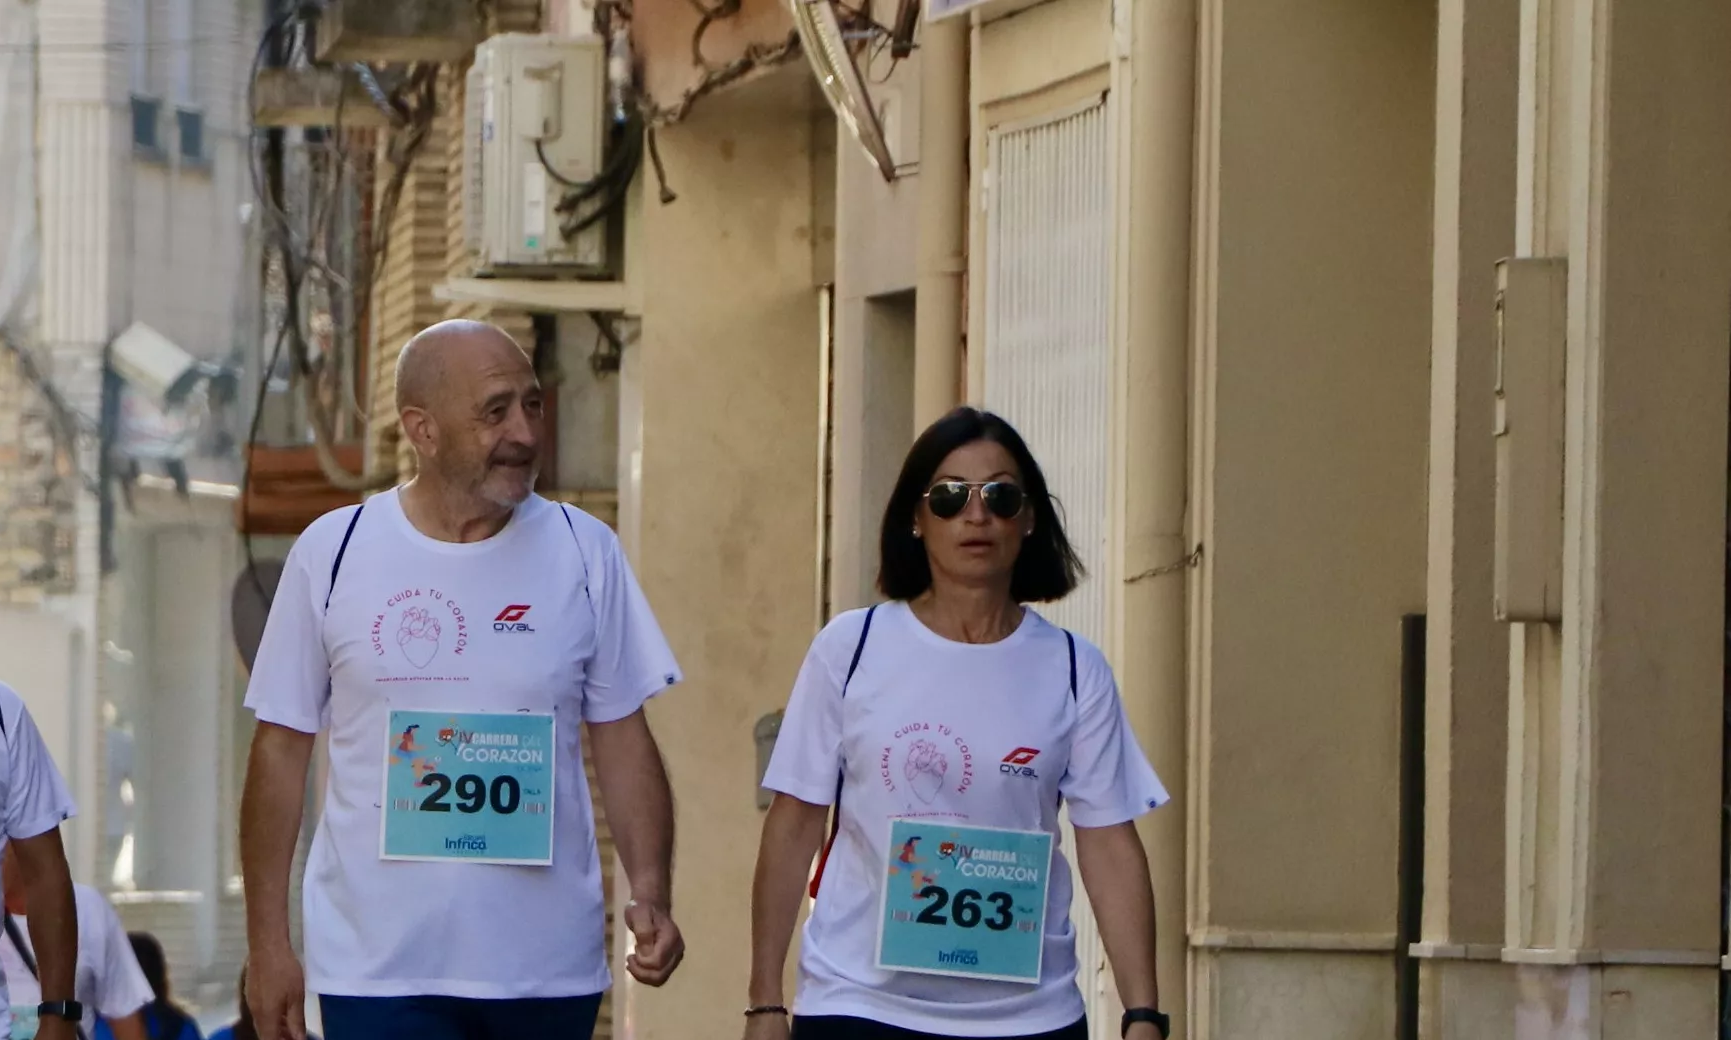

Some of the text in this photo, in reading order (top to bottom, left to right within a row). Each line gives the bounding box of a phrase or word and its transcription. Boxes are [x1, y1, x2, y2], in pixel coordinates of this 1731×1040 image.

[387, 588, 421, 607] CUIDA
[428, 588, 442, 600] TU
[471, 732, 518, 747] CARRERA
[894, 722, 930, 739] CUIDA
[937, 724, 952, 736] TU
[419, 772, 520, 815] 290
[971, 849, 1017, 863] CARRERA
[916, 885, 1013, 931] 263
